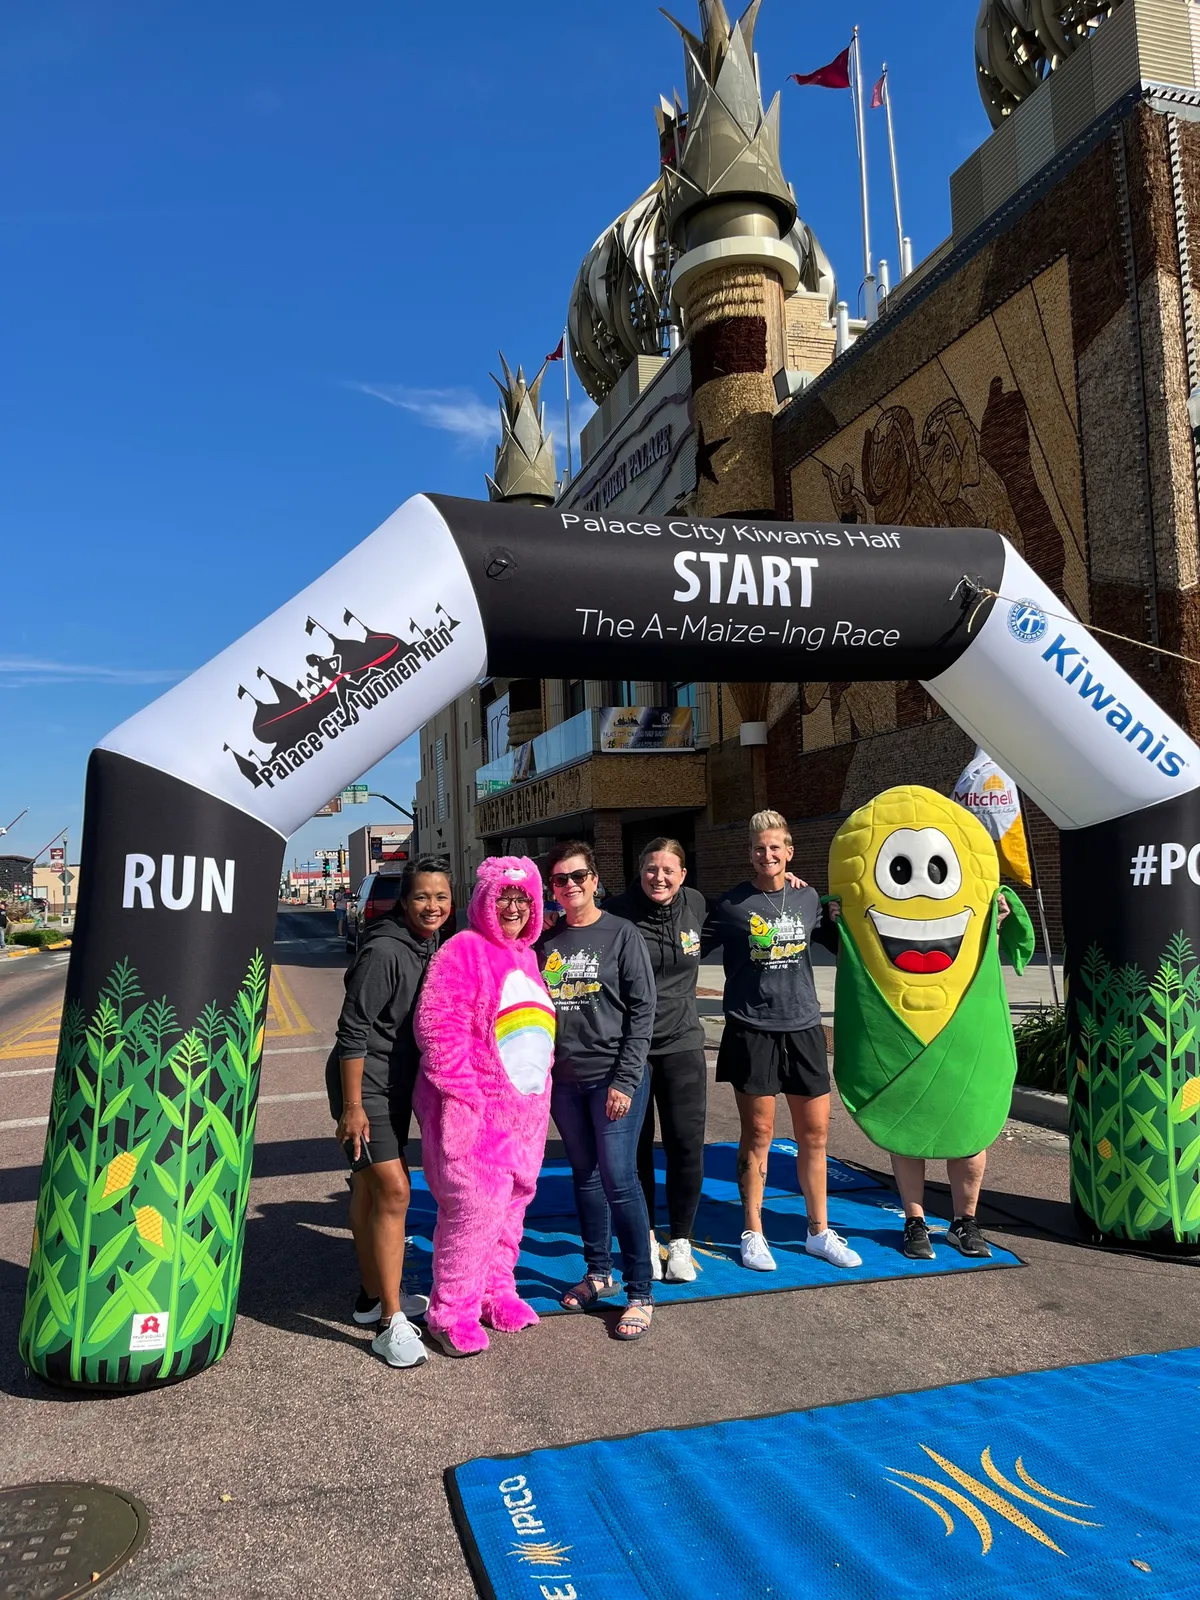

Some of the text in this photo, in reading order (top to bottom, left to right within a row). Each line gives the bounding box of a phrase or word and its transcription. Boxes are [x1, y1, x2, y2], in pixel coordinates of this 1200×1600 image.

[628, 423, 672, 483] PALACE
[561, 513, 902, 549] Palace City Kiwanis Half
[673, 551, 819, 608] START
[575, 608, 900, 650] The A-Maize-Ing Race
[260, 732, 324, 788] Palace
[355, 651, 422, 711] Women
[418, 622, 454, 662] Run
[1041, 633, 1185, 778] Kiwanis
[480, 800, 500, 833] UNDER
[501, 793, 515, 827] THE
[516, 787, 531, 824] BIG
[531, 780, 550, 819] TOP
[954, 790, 1014, 807] Mitchell
[122, 853, 236, 914] RUN
[499, 1475, 546, 1535] IPICO
